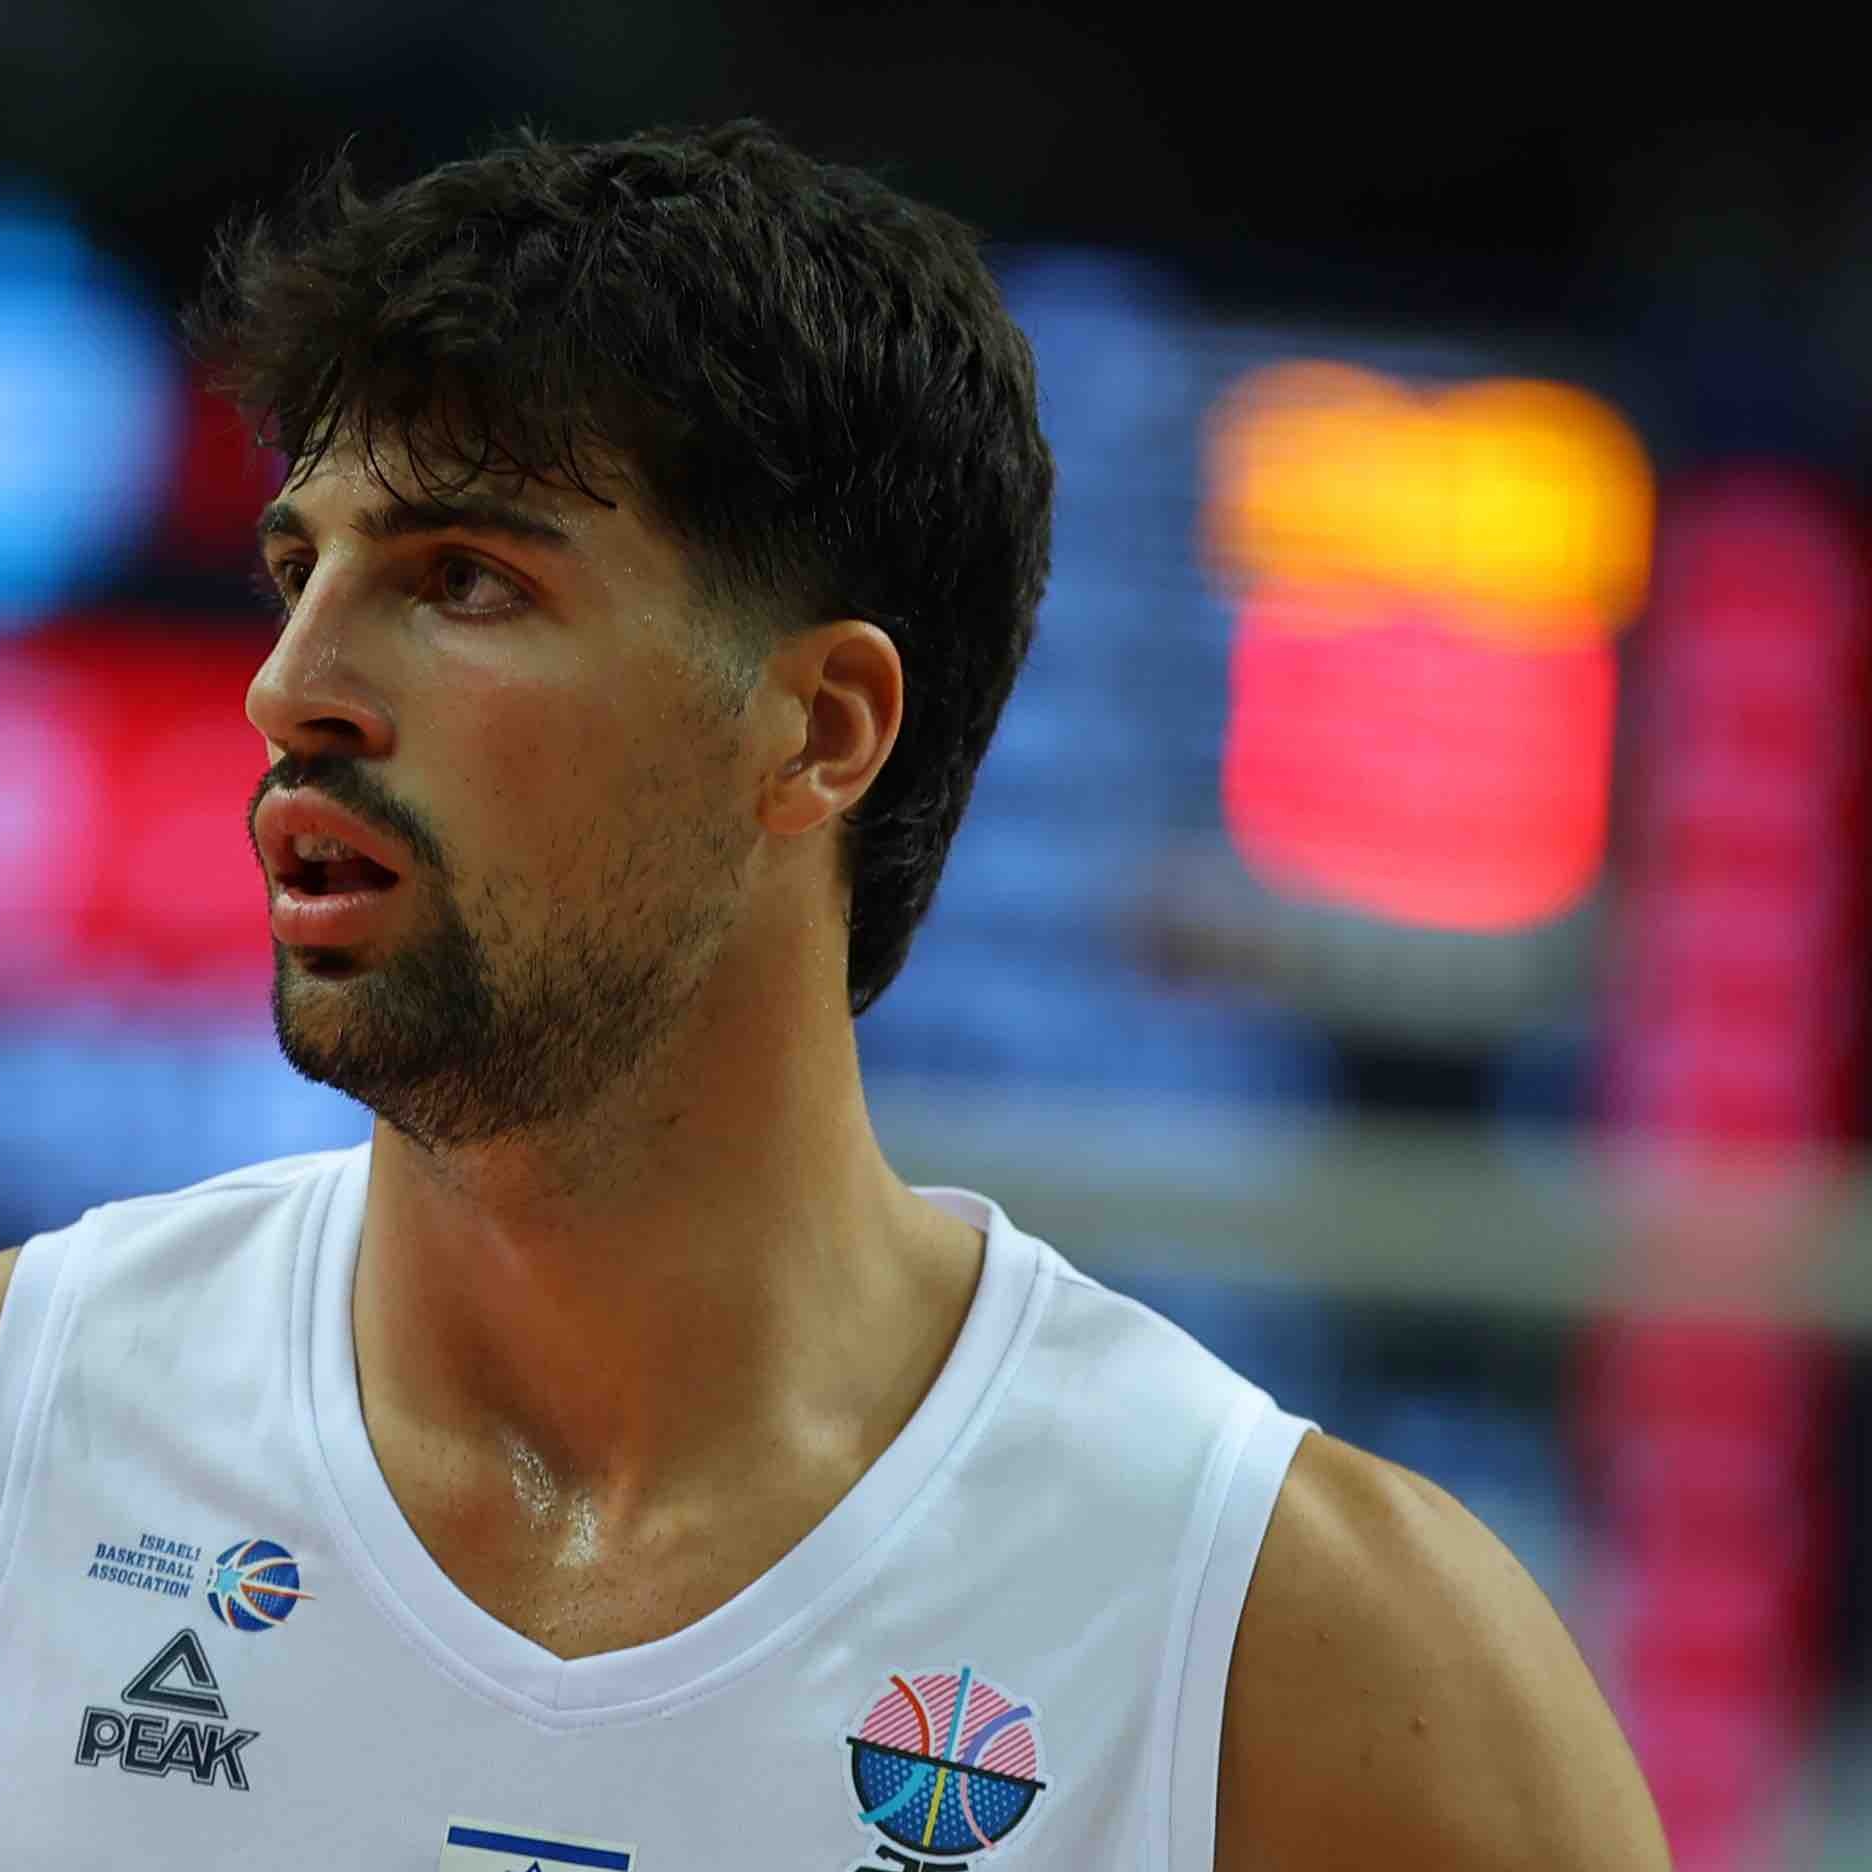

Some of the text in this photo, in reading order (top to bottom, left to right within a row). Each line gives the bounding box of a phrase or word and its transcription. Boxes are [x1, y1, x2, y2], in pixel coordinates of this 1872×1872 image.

[95, 1542, 194, 1579] BASKETBALL
[139, 1533, 201, 1561] ISRAELI
[88, 1562, 190, 1598] ASSOCIATION
[75, 1706, 260, 1791] PEAK
